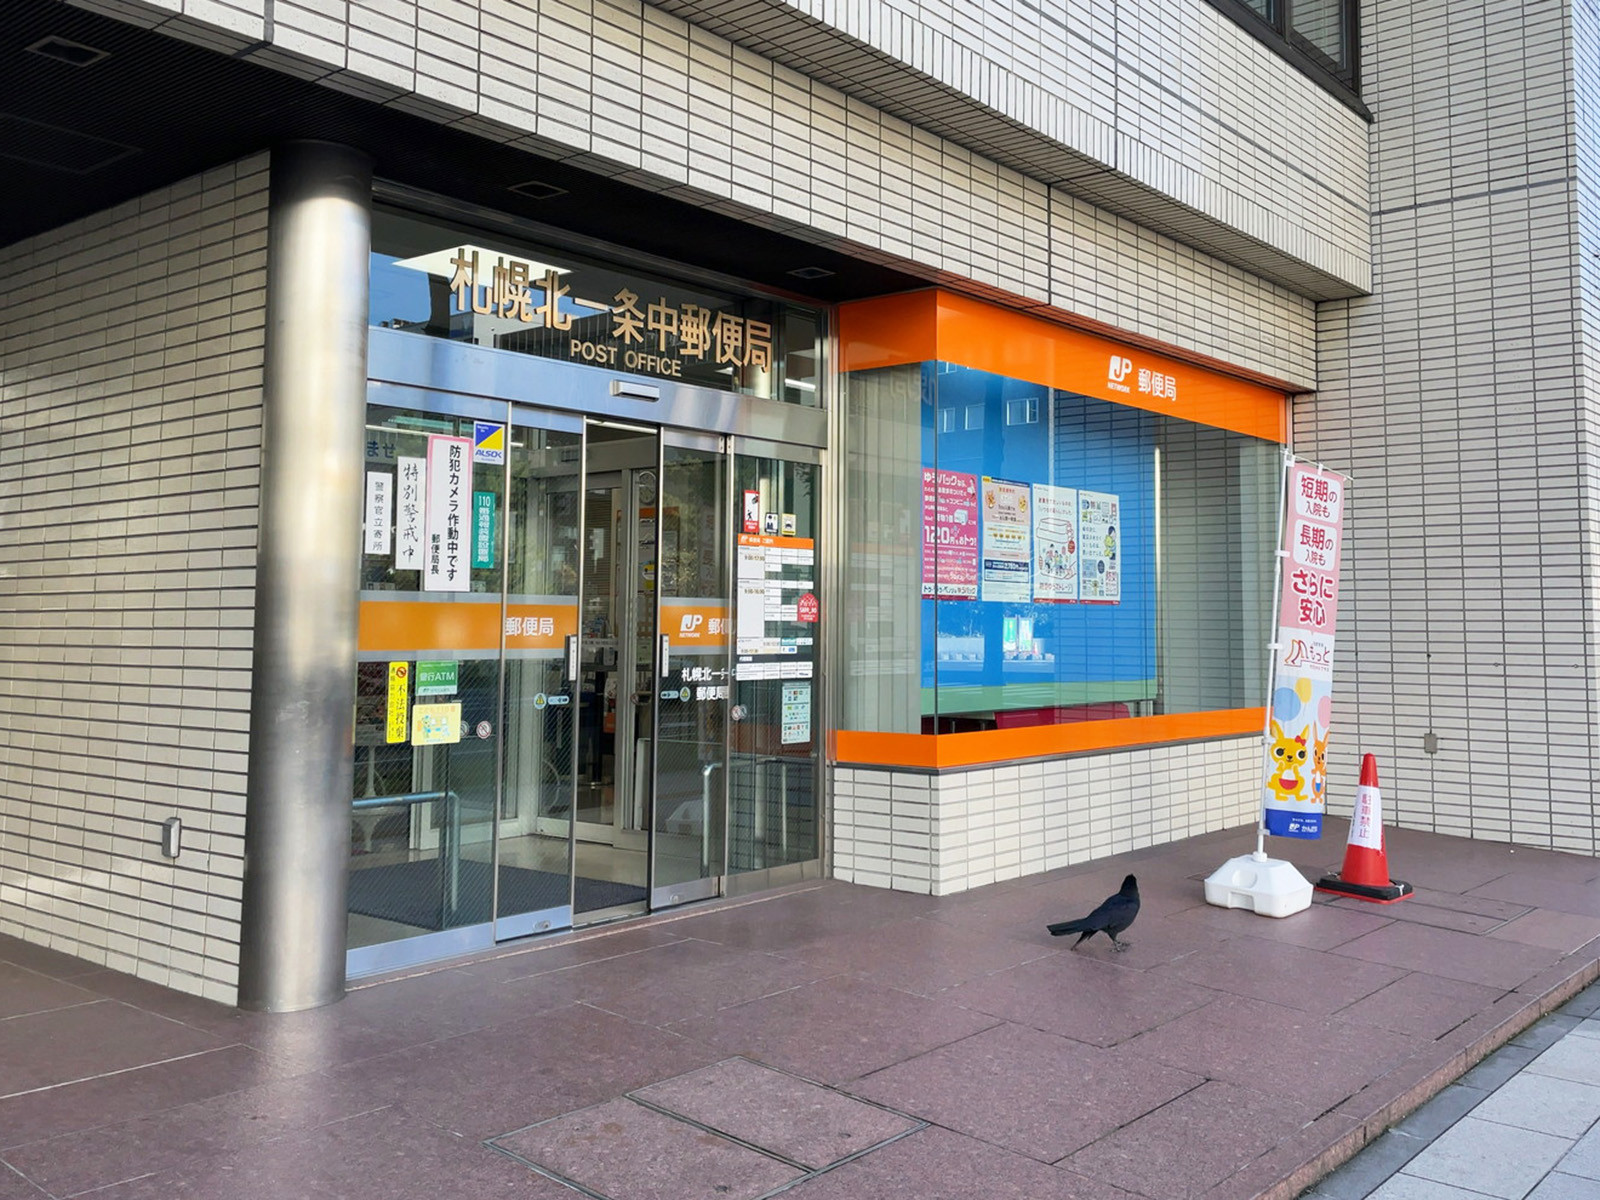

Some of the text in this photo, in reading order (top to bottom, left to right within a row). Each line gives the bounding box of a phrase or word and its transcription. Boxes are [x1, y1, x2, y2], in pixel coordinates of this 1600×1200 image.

[450, 248, 771, 373] 札幌北一条中郵便局
[570, 339, 682, 377] POST OFFICE
[1138, 368, 1176, 401] 郵便局
[475, 449, 502, 459] ALSOK
[1301, 475, 1338, 503] 短期の
[372, 481, 385, 551] 警察官立寄所
[402, 463, 419, 563] 特別警戒中
[446, 445, 461, 581] 防犯カメラ作動中です
[1305, 501, 1331, 518] 入院も
[1300, 524, 1334, 550] 長期の
[430, 533, 441, 575] 郵便局長
[1305, 549, 1326, 566] 入院も
[1292, 569, 1334, 599] さらに
[1299, 597, 1326, 626] 安心
[505, 617, 554, 637] 郵便局
